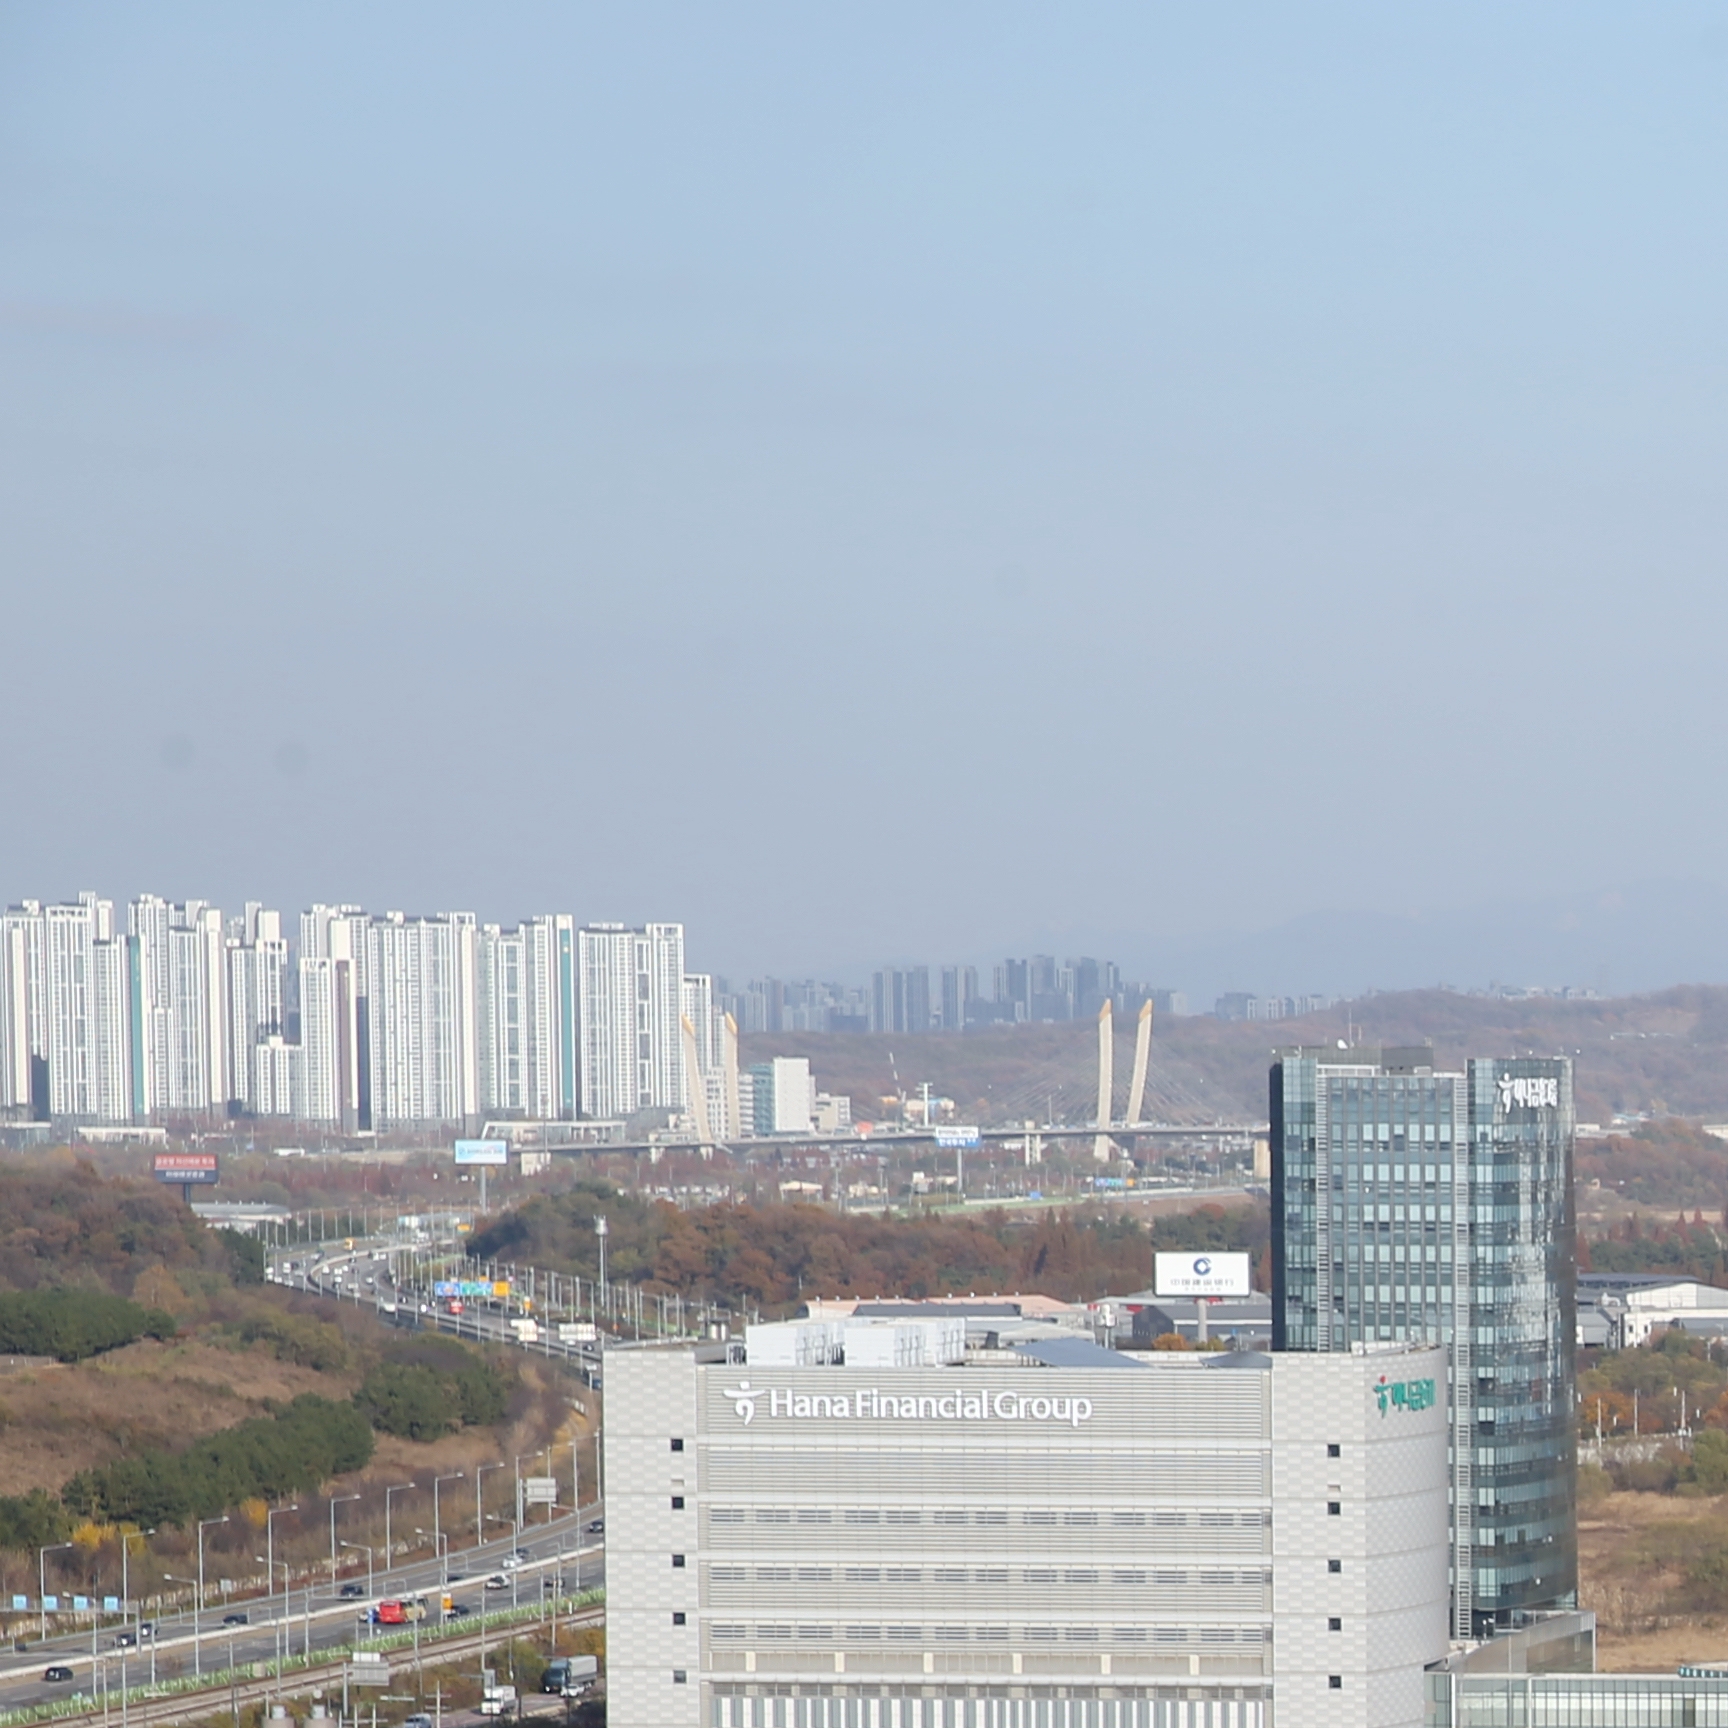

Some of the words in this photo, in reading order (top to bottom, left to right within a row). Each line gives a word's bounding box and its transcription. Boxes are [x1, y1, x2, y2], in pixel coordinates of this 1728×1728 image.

[769, 1389, 850, 1418] Hana
[855, 1388, 989, 1419] Financial
[993, 1390, 1093, 1428] Group
